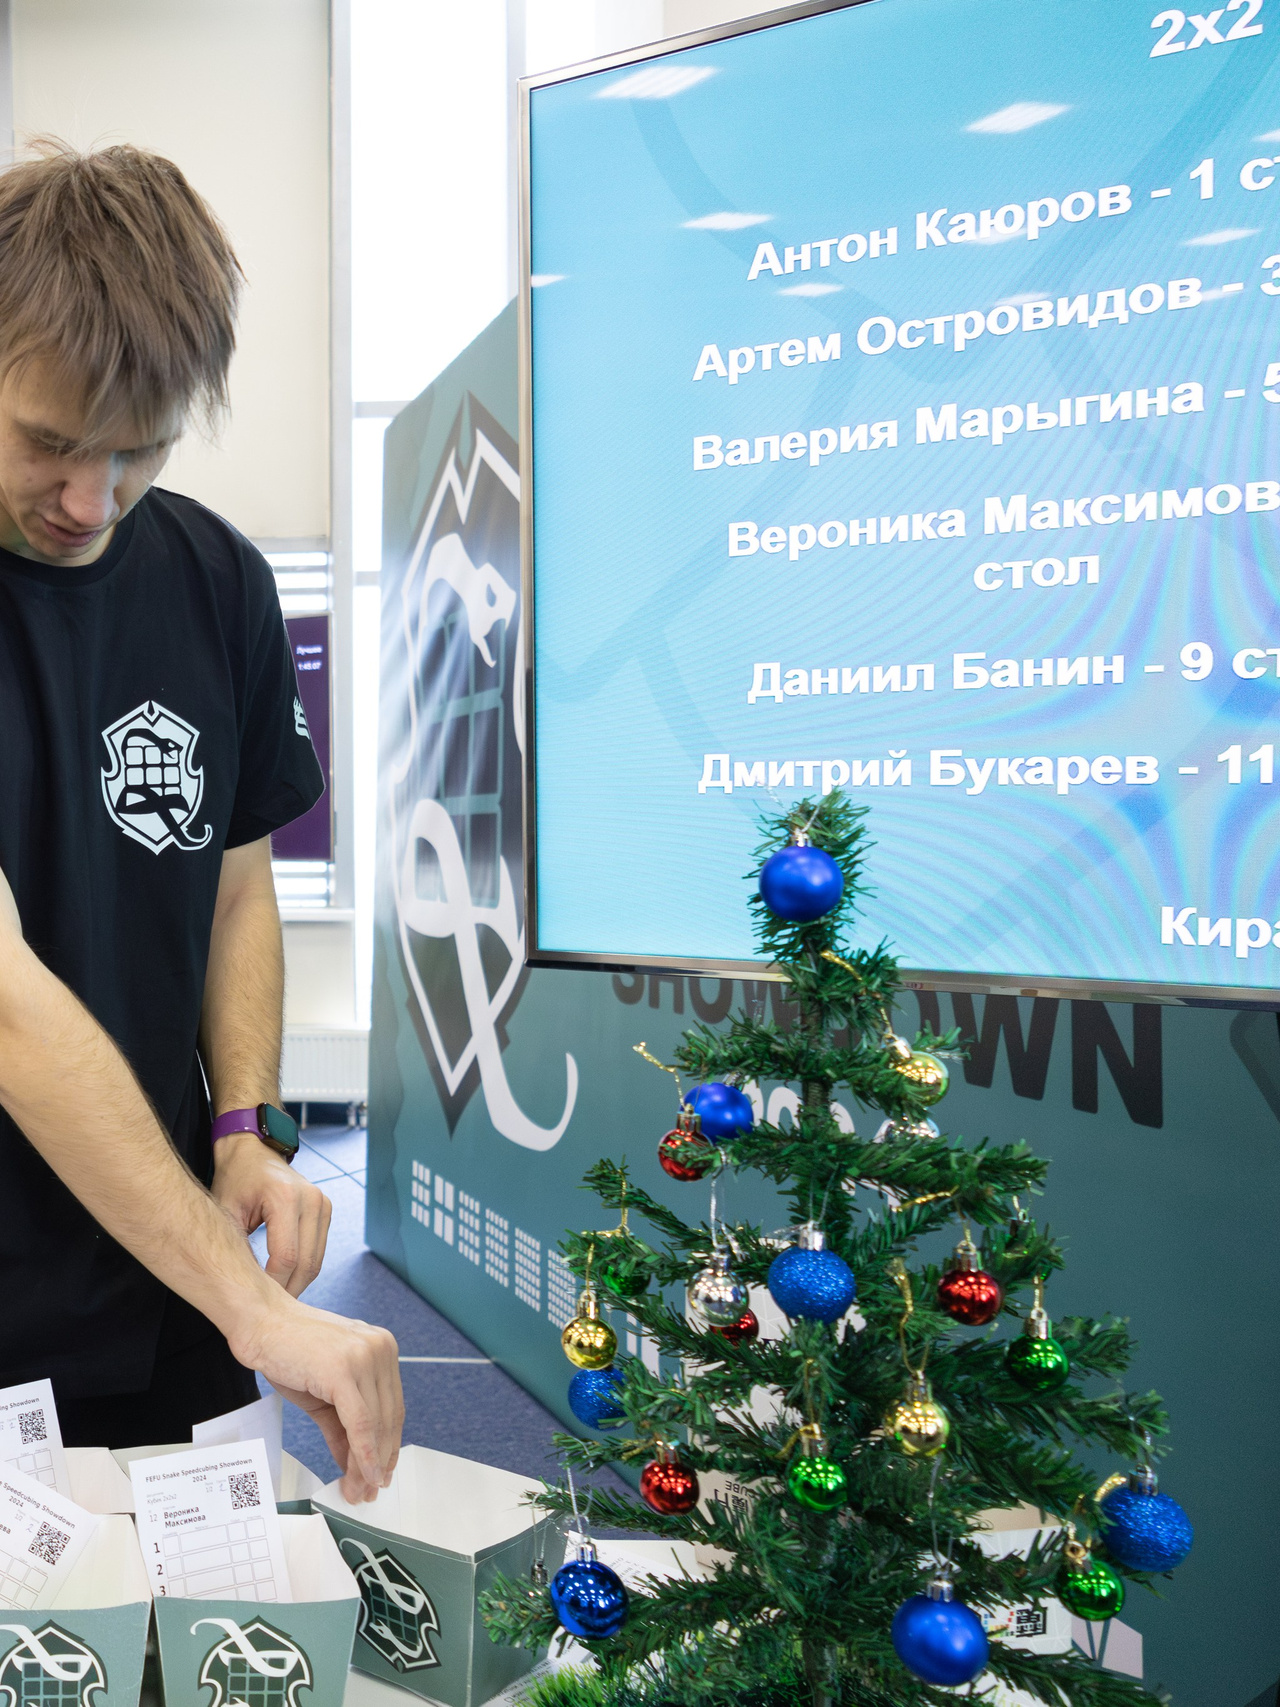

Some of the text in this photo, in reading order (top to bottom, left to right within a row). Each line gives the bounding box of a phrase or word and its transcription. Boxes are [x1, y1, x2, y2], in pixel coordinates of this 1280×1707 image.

[1149, 0, 1264, 59] 2x2
[747, 224, 898, 281] Антон
[915, 183, 1132, 251] Каюров
[1189, 157, 1214, 200] 1
[1239, 155, 1280, 192] с
[692, 329, 842, 385] Артем
[856, 276, 1204, 357] Островидов
[692, 413, 899, 471] Валерия
[915, 381, 1205, 446] Марыгина
[726, 505, 968, 561] Вероника
[973, 553, 1102, 592] стол
[747, 659, 936, 704] Даниил
[952, 647, 1126, 693] Банин
[1179, 640, 1214, 681] 9
[698, 750, 913, 796] Дмитрий
[927, 749, 1161, 797] Букарев
[1216, 744, 1274, 784] 11
[1161, 906, 1280, 958] Кир
[145, 1475, 161, 1483] FEFU
[162, 1472, 180, 1480] Snake
[192, 1474, 207, 1483] 2024
[9, 1495, 24, 1508] 2024
[164, 1506, 199, 1519] Вероника
[165, 1515, 206, 1528] Максимова
[154, 1542, 161, 1554] 1
[156, 1564, 163, 1576] 2
[159, 1585, 166, 1597] 3
